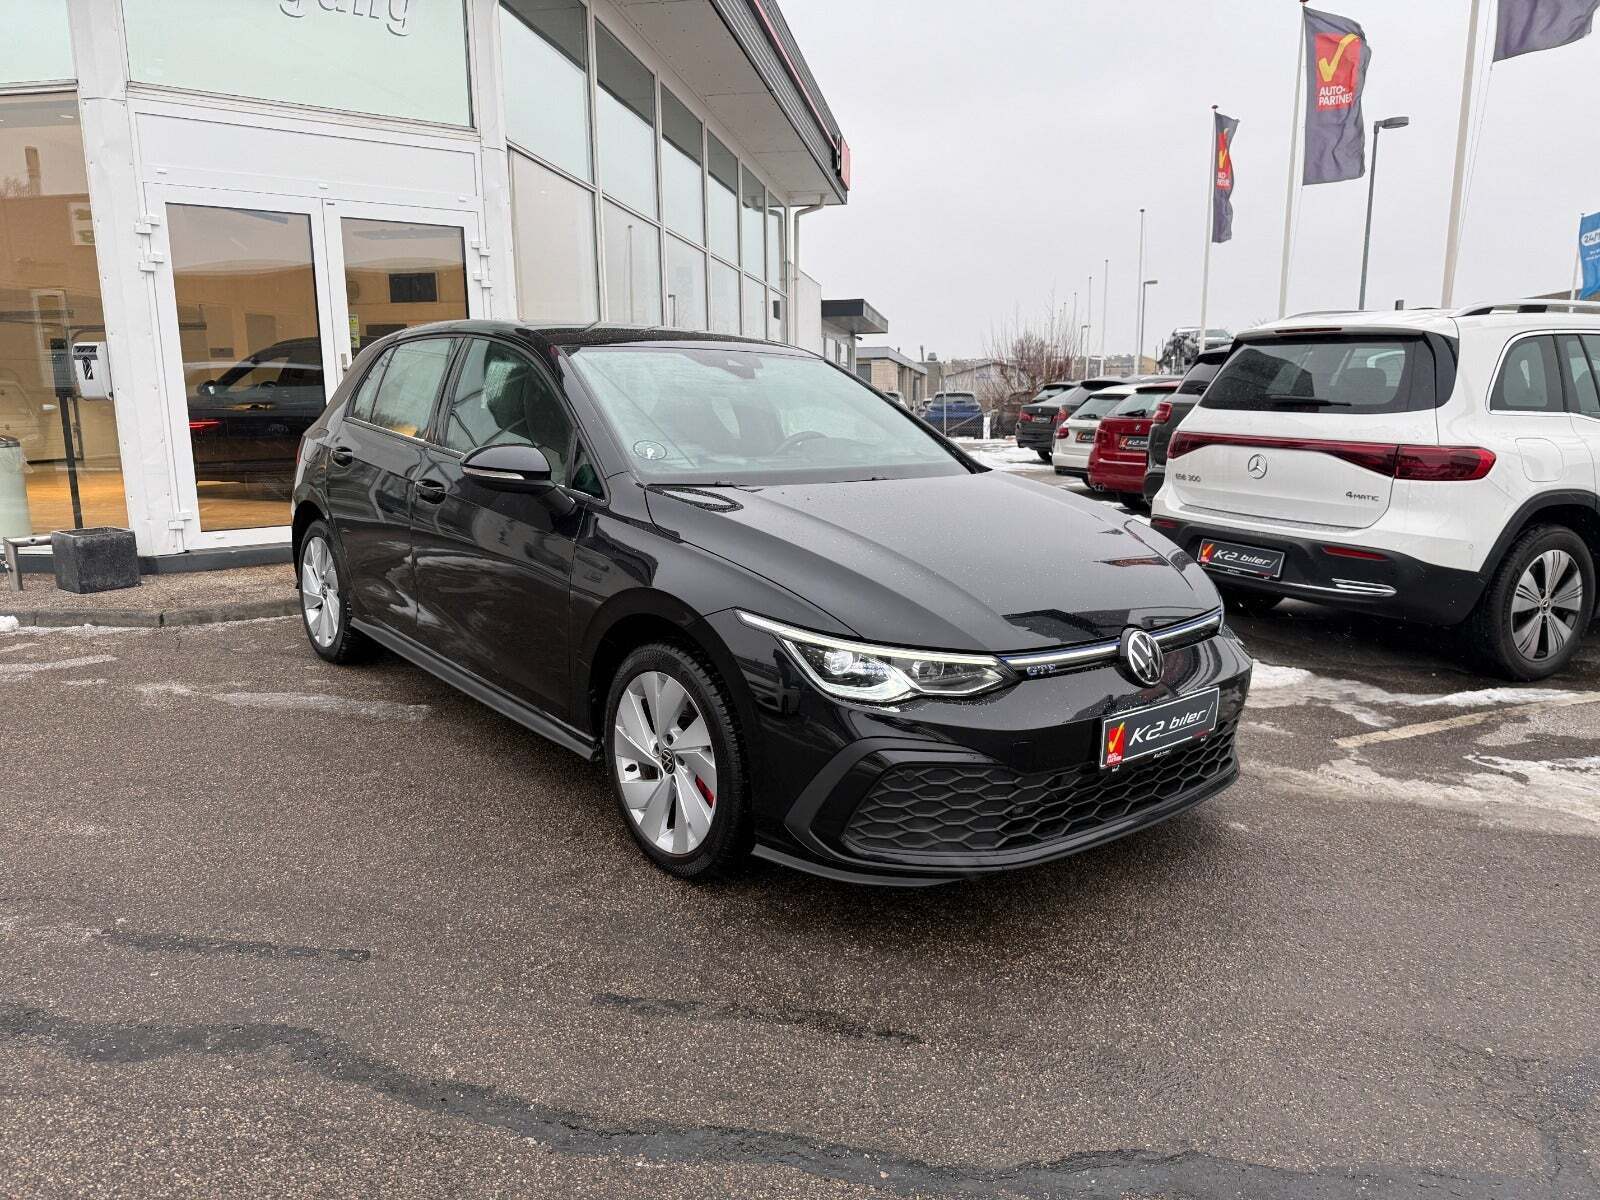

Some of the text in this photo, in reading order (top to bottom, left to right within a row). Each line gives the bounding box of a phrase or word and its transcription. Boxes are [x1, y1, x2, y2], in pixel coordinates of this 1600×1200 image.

[1319, 84, 1346, 97] AUTO-
[1318, 92, 1353, 106] PARTNER
[1214, 549, 1238, 561] K2
[1240, 554, 1271, 565] biler
[1129, 709, 1206, 746] K2 biler
